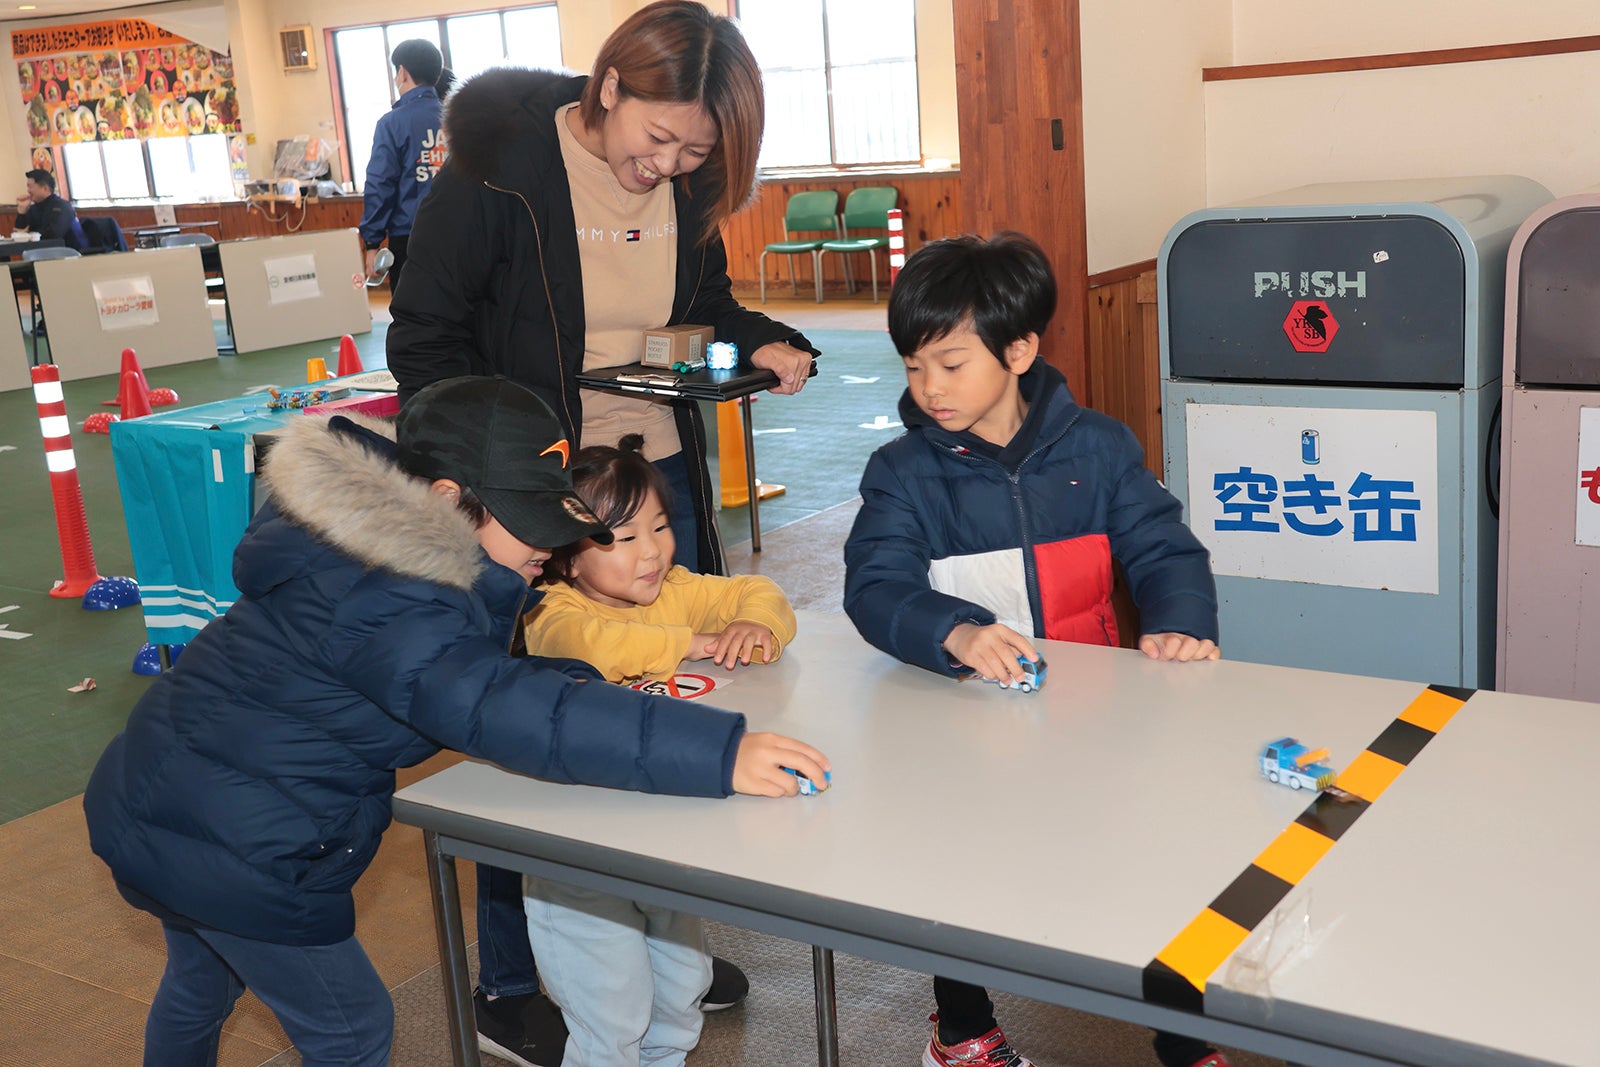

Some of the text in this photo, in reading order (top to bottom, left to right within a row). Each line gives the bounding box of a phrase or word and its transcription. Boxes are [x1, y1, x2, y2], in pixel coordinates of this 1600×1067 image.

[1253, 270, 1367, 298] PUSH
[1212, 466, 1421, 542] 空き缶
